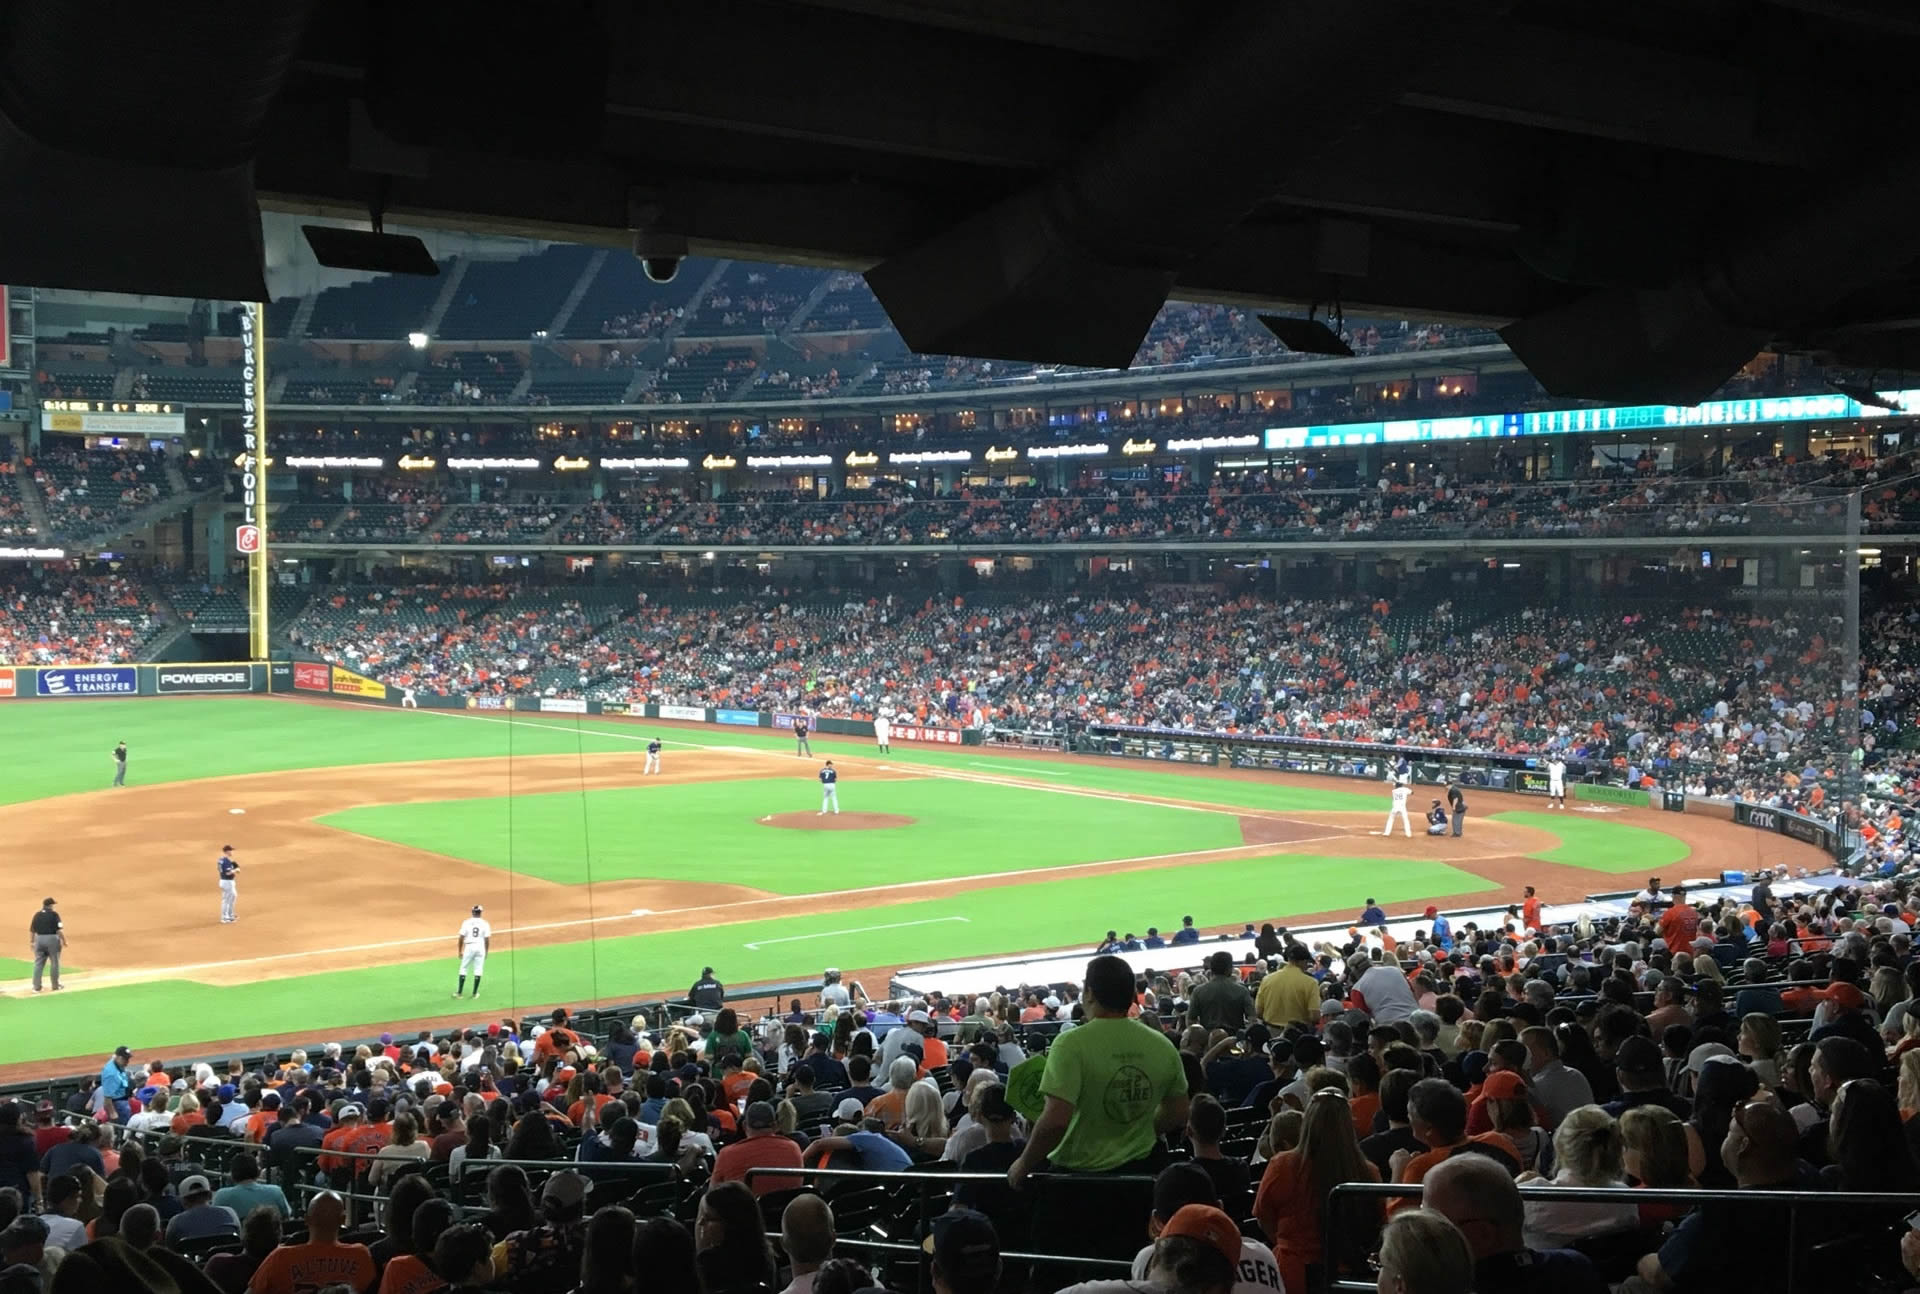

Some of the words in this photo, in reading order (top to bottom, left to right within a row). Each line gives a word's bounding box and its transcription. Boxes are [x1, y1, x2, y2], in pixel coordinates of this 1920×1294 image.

[242, 455, 256, 523] FOUL
[75, 673, 119, 683] ENERGY
[161, 673, 245, 684] POWERADE
[75, 682, 131, 692] TRANSFER
